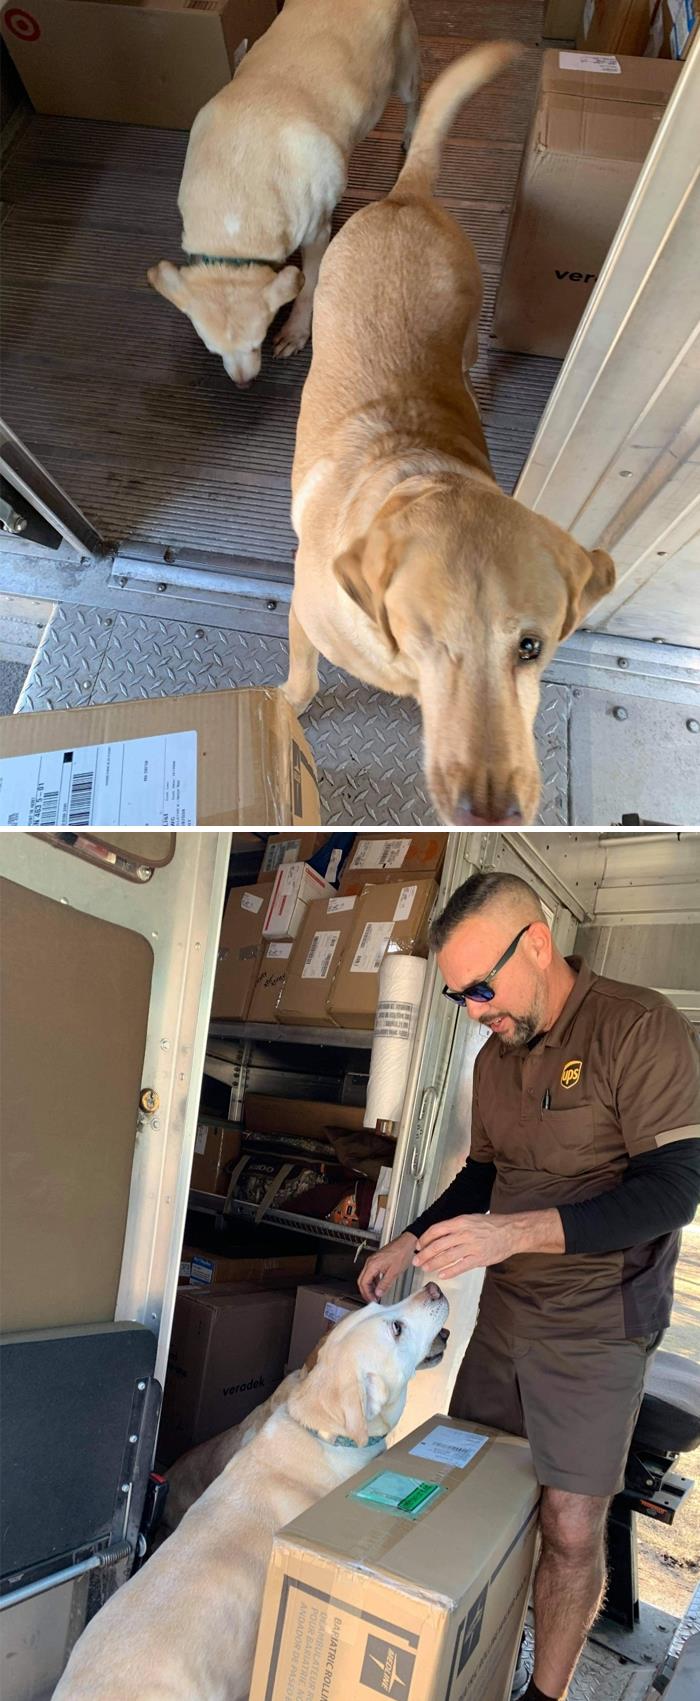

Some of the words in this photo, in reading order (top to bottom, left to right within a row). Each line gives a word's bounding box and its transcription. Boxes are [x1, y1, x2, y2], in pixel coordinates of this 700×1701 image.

[555, 270, 597, 283] ver
[563, 1068, 580, 1085] ups
[223, 1376, 264, 1396] veradek
[326, 1617, 342, 1670] BARIATRIC
